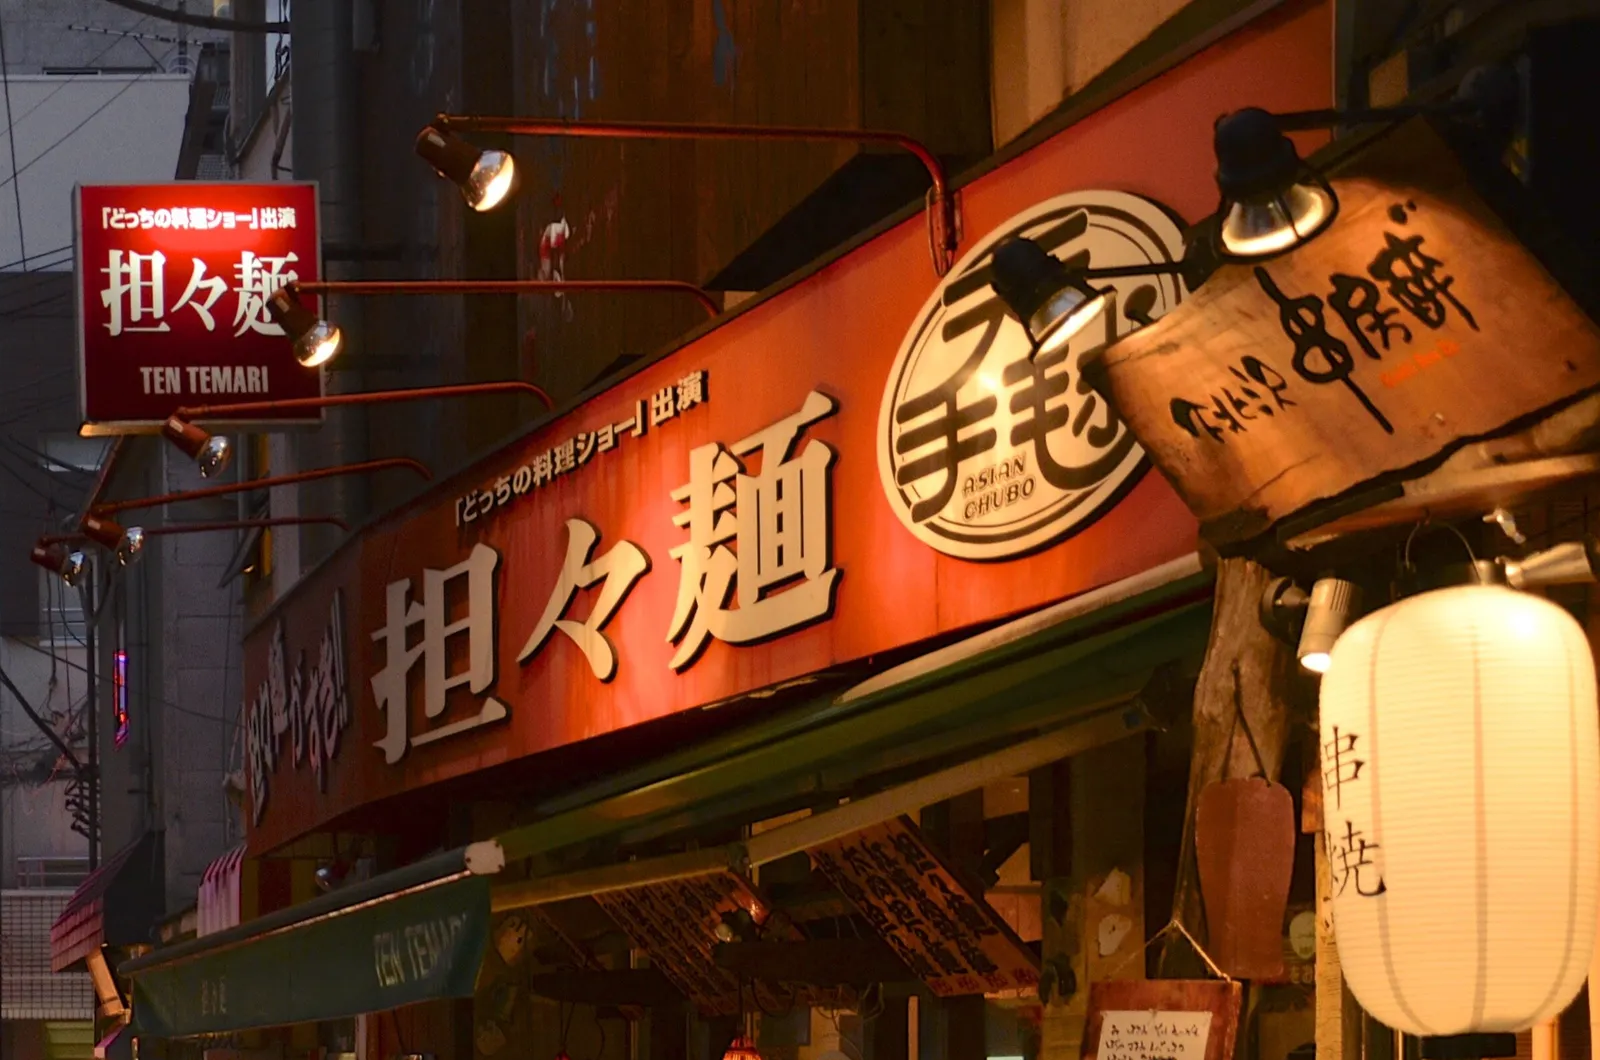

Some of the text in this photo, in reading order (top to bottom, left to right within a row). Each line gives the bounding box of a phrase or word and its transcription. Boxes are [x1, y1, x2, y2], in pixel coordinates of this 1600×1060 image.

[100, 249, 299, 338] 担々麺
[140, 366, 269, 394] TEN TEMARI
[962, 449, 1027, 498] ASIAN
[963, 475, 1036, 521] CHUBO
[369, 389, 842, 765] 担々麺
[1322, 726, 1387, 899] 串焼
[372, 929, 406, 989] TEN
